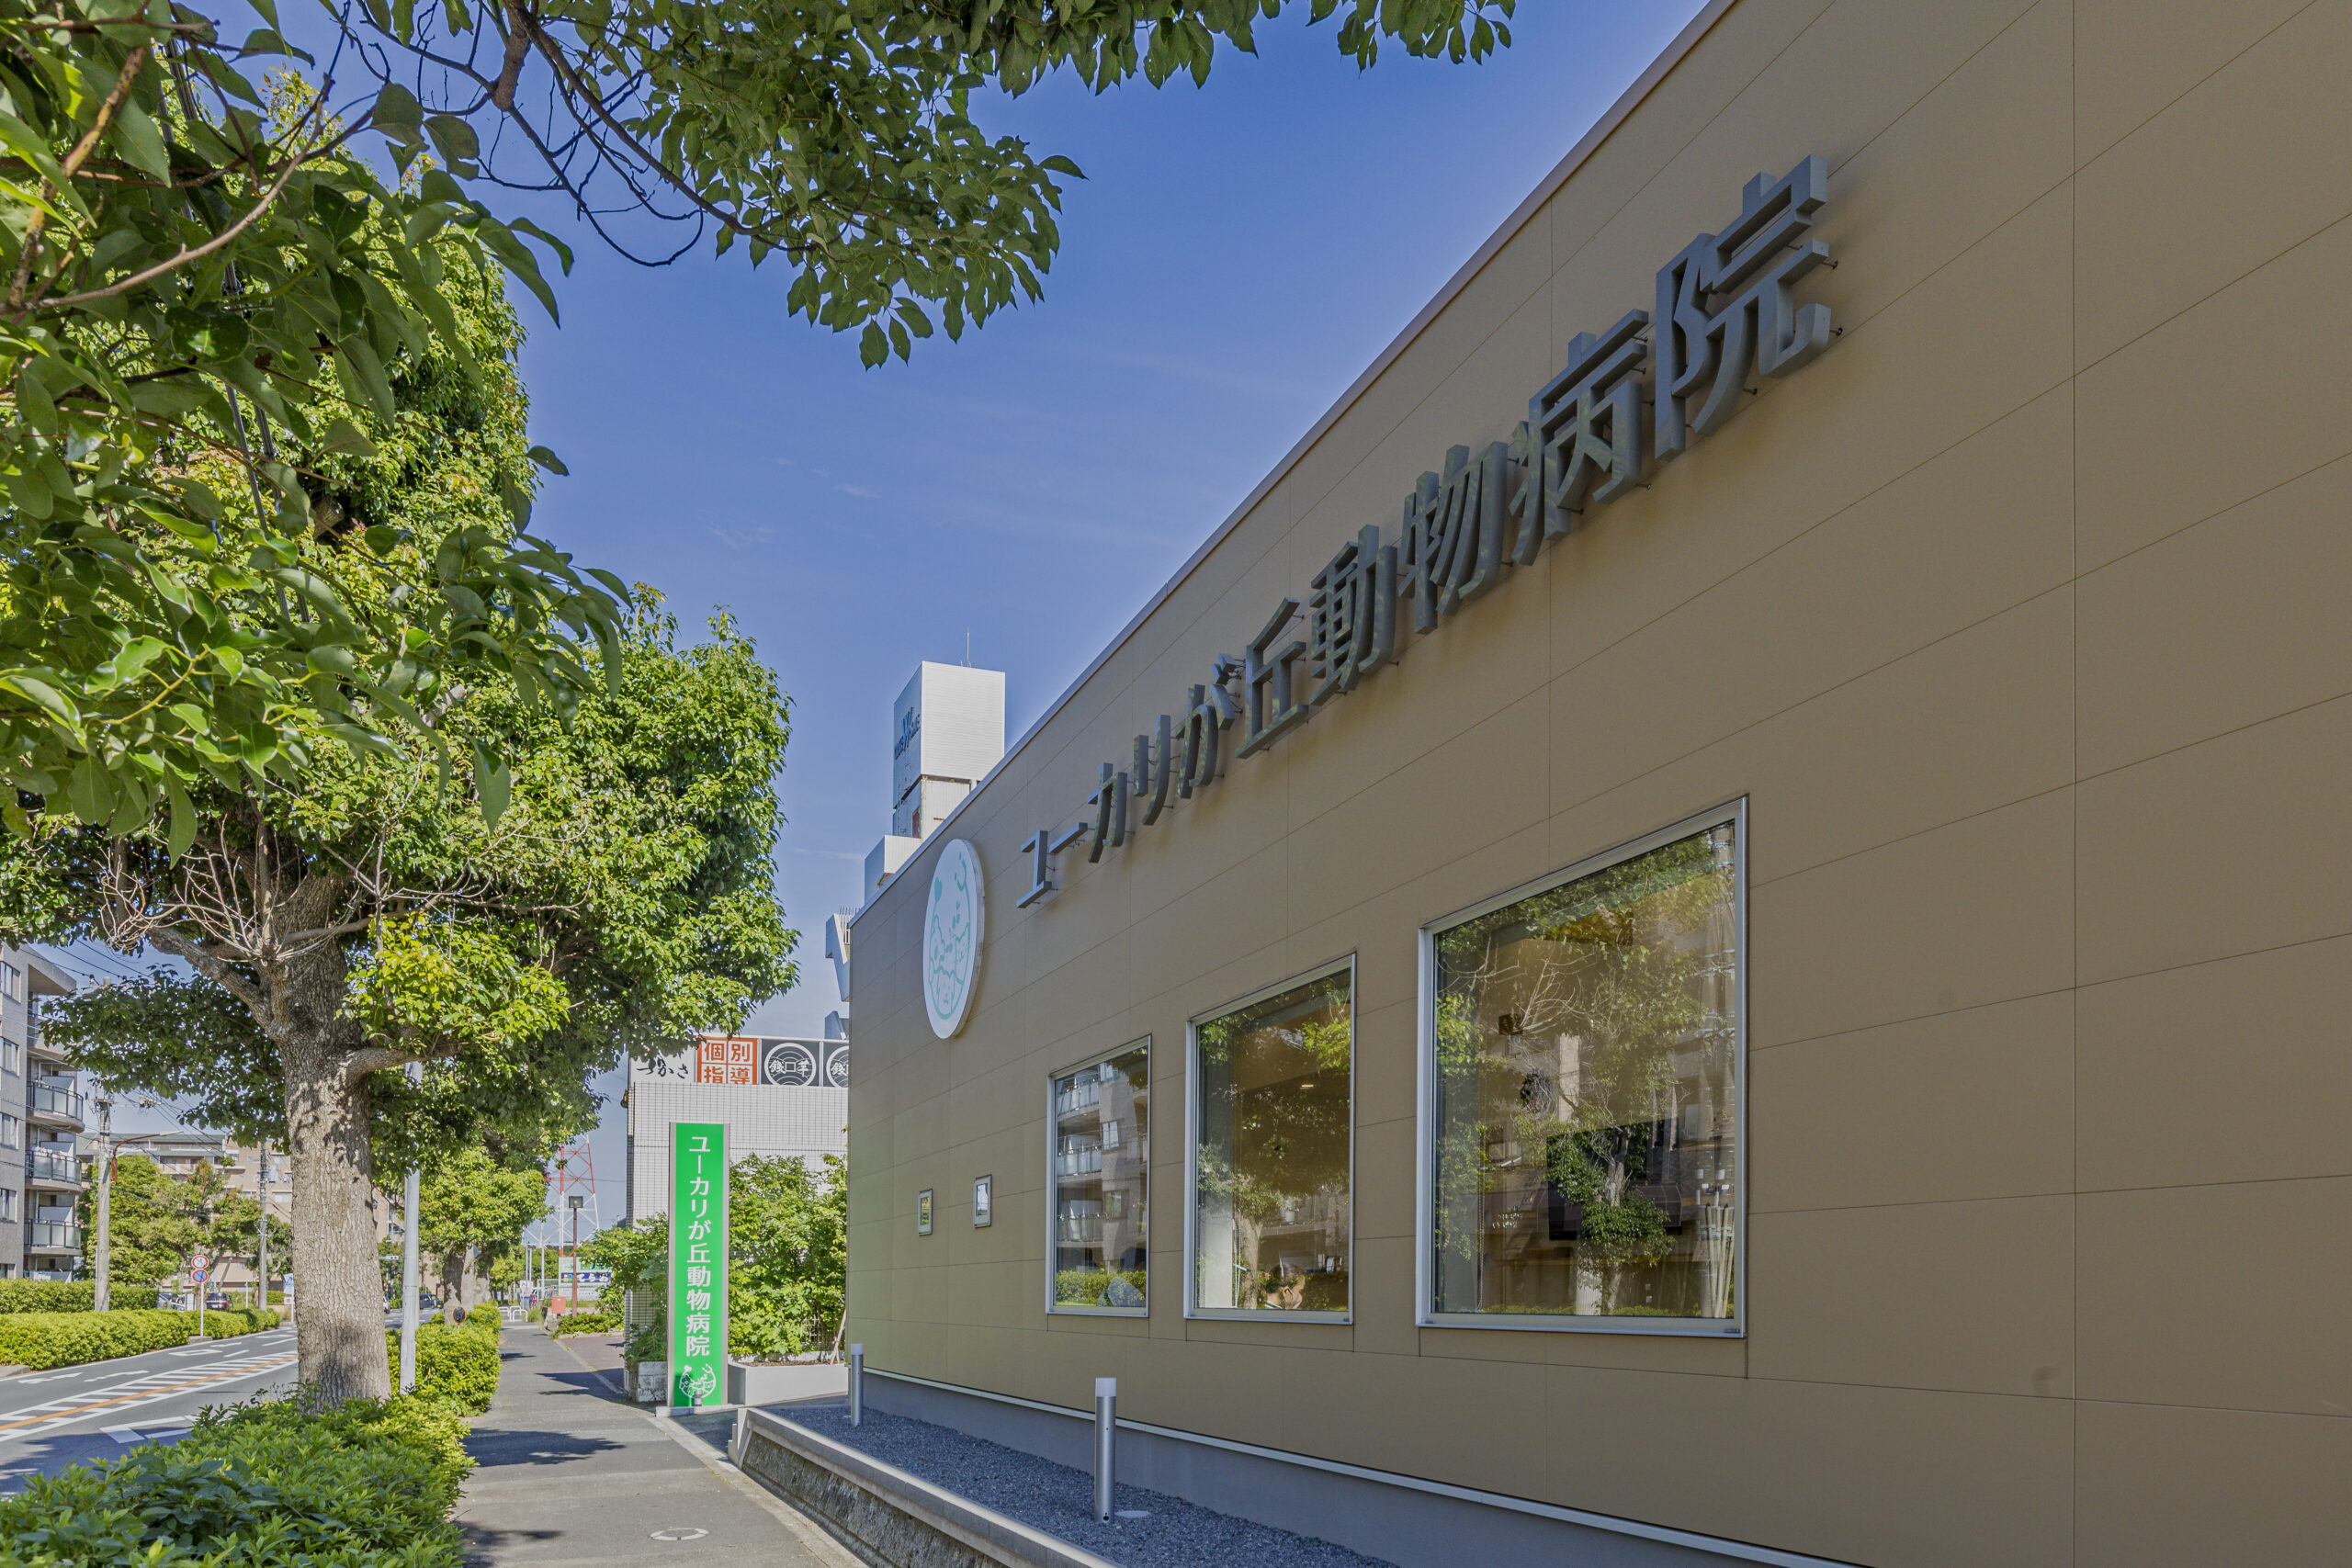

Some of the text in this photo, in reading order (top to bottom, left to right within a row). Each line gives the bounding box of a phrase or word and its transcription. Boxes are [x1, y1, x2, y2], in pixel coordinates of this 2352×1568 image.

[1017, 154, 1832, 908] ユーカリが丘動物病院
[704, 1042, 751, 1062] 個別
[704, 1066, 751, 1084] 指導
[686, 1136, 711, 1358] ユーカリが丘動物病院
